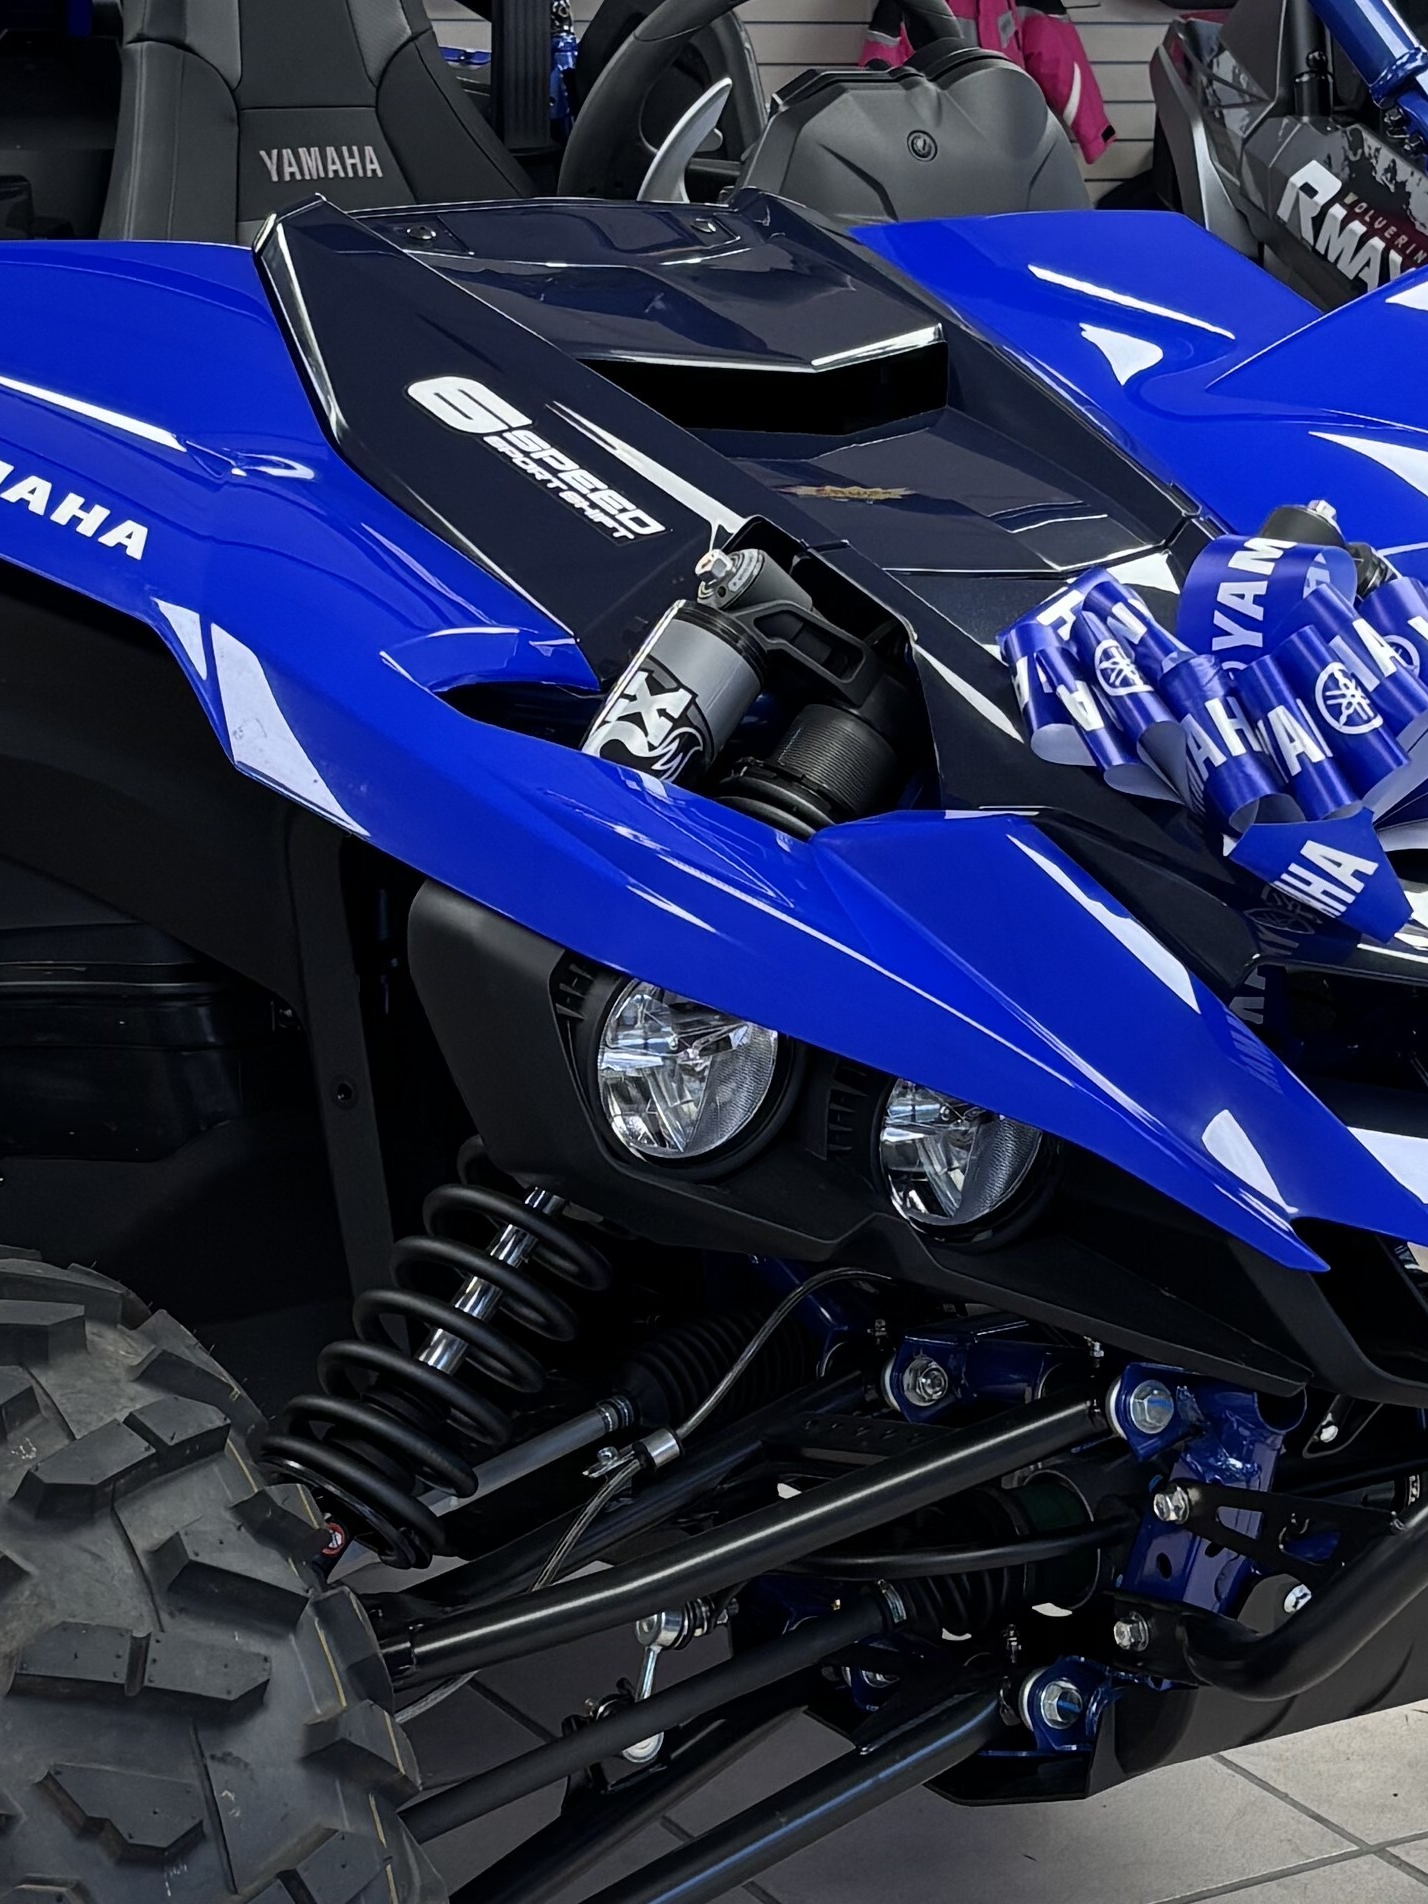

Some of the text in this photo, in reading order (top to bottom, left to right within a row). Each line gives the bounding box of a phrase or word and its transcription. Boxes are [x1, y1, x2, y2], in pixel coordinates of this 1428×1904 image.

[258, 145, 384, 182] YAMAHA
[406, 375, 667, 536] 6 SPEED
[482, 435, 636, 540] SPORT SHIFT
